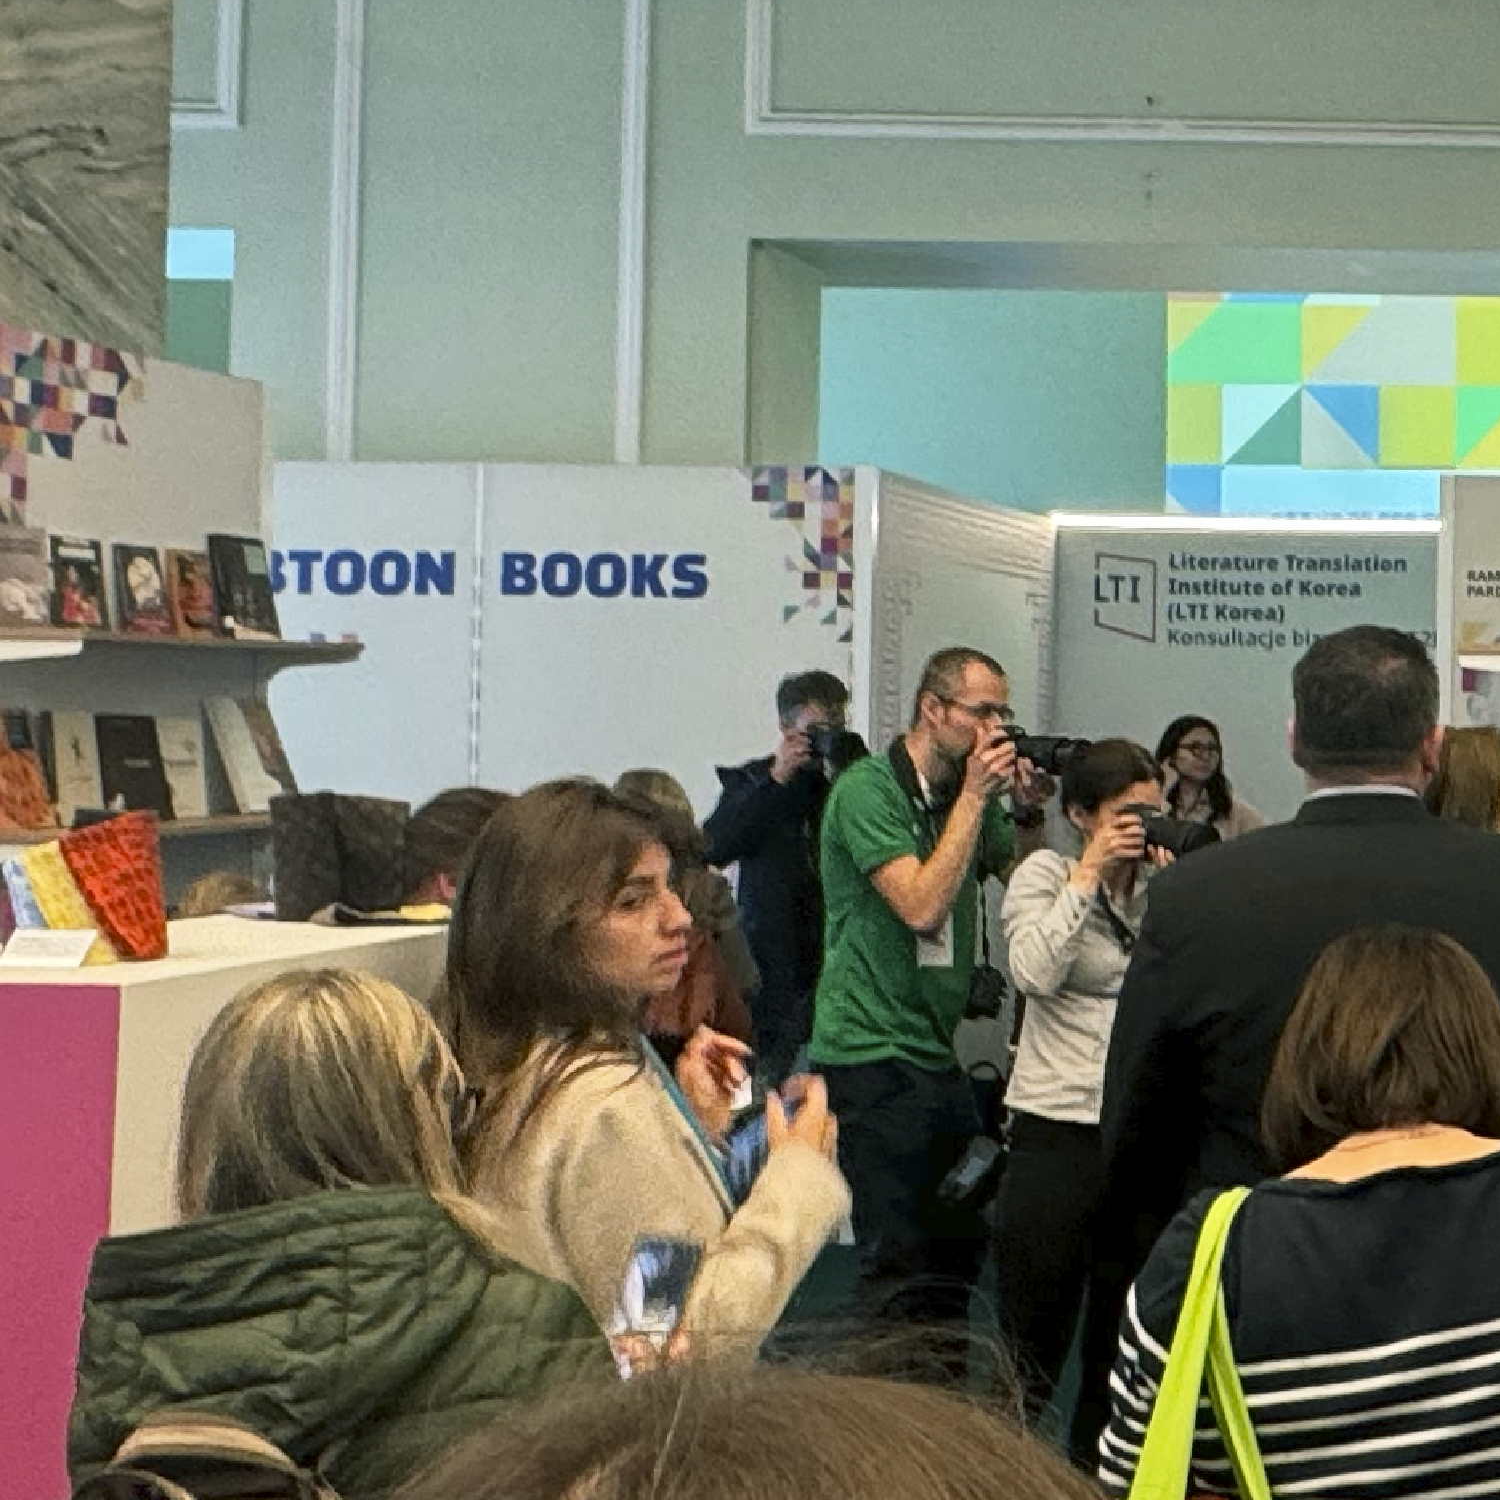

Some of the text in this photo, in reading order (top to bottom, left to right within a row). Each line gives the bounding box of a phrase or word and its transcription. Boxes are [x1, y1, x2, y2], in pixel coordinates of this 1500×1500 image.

[1168, 553, 1408, 573] Literature Translation
[501, 552, 709, 599] BOOKS
[1094, 575, 1140, 603] LTI
[1168, 577, 1362, 597] Institute of Korea
[1167, 603, 1286, 623] (LTI Korea)
[1168, 629, 1287, 650] Konsultacje
